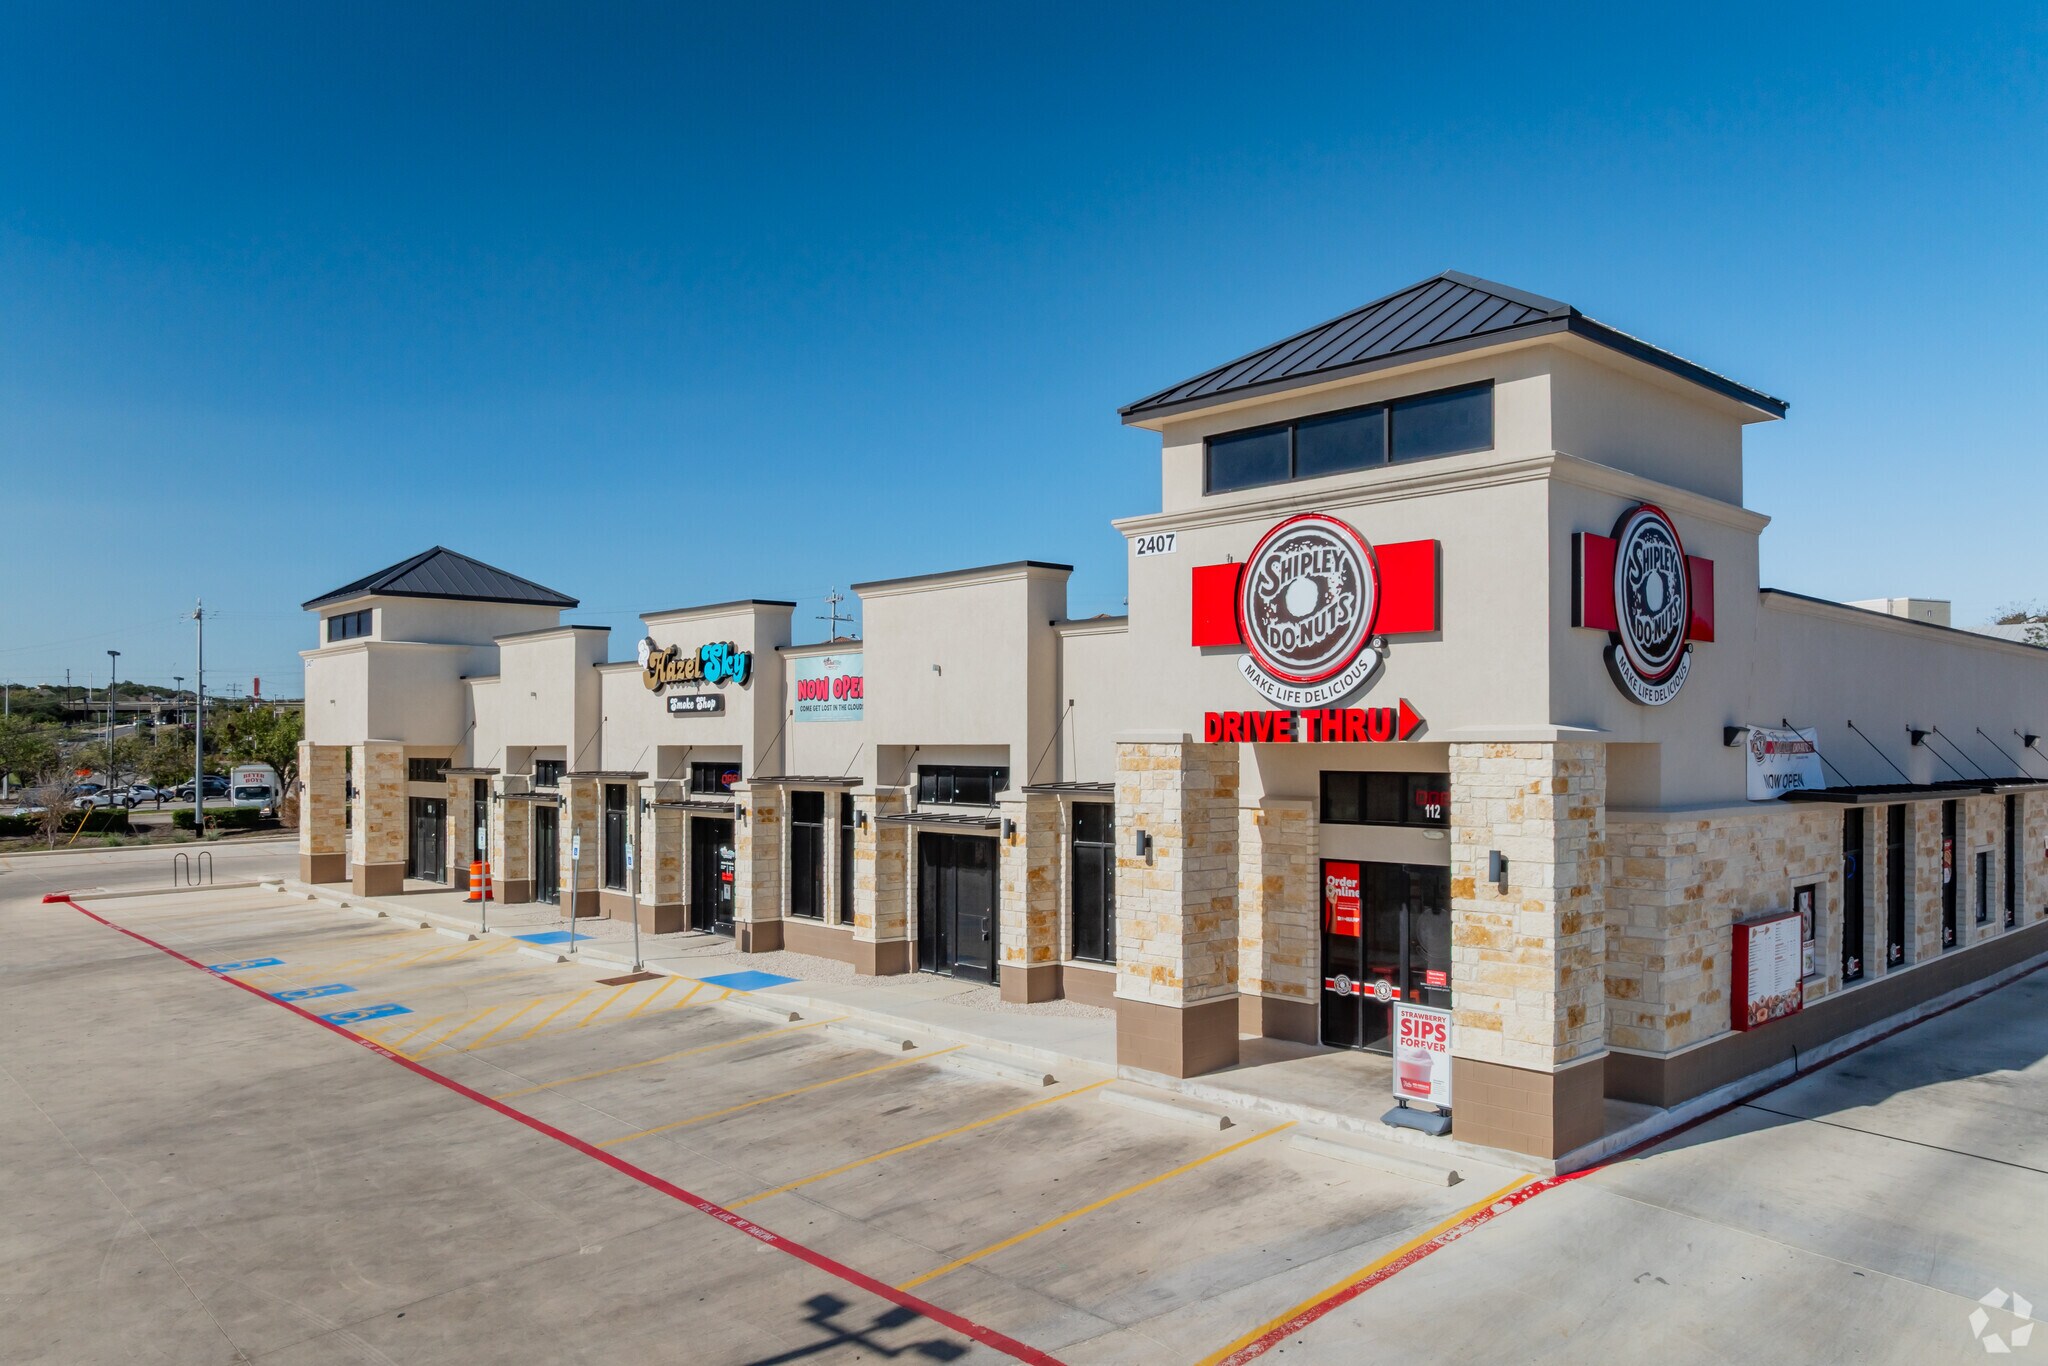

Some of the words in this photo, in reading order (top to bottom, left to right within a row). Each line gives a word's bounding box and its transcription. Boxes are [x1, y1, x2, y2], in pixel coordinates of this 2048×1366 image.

[1136, 534, 1175, 555] 2407
[1260, 549, 1346, 597] SHIPLEY
[1630, 541, 1676, 585] SHIPLEY
[643, 647, 701, 690] Hazel
[702, 644, 746, 684] Sky
[1618, 656, 1637, 692] MAKE
[1638, 684, 1652, 701] LIFE
[1654, 662, 1687, 702] DELICIOUS
[798, 676, 829, 702] NOW
[1244, 664, 1275, 695] MAKE
[1276, 687, 1301, 703] LIFE
[1304, 659, 1368, 704] DELICIOUS
[670, 698, 694, 712] Smoke
[696, 695, 716, 710] Shop
[822, 704, 832, 712] LOST
[1204, 710, 1291, 742] DRIVE
[1300, 707, 1392, 742] THRU
[1763, 774, 1782, 788] NOW
[1782, 773, 1804, 788] OPEN
[1424, 804, 1440, 818] 112
[1326, 876, 1358, 888] Order
[1400, 1010, 1446, 1022] STRAWBERRY
[1400, 1018, 1446, 1042] SIPS
[1400, 1036, 1446, 1053] FOREVER
[697, 1203, 716, 1212] FIRE
[713, 1210, 737, 1222] LANE
[734, 1220, 749, 1228] NO
[746, 1226, 777, 1242] PARKING
